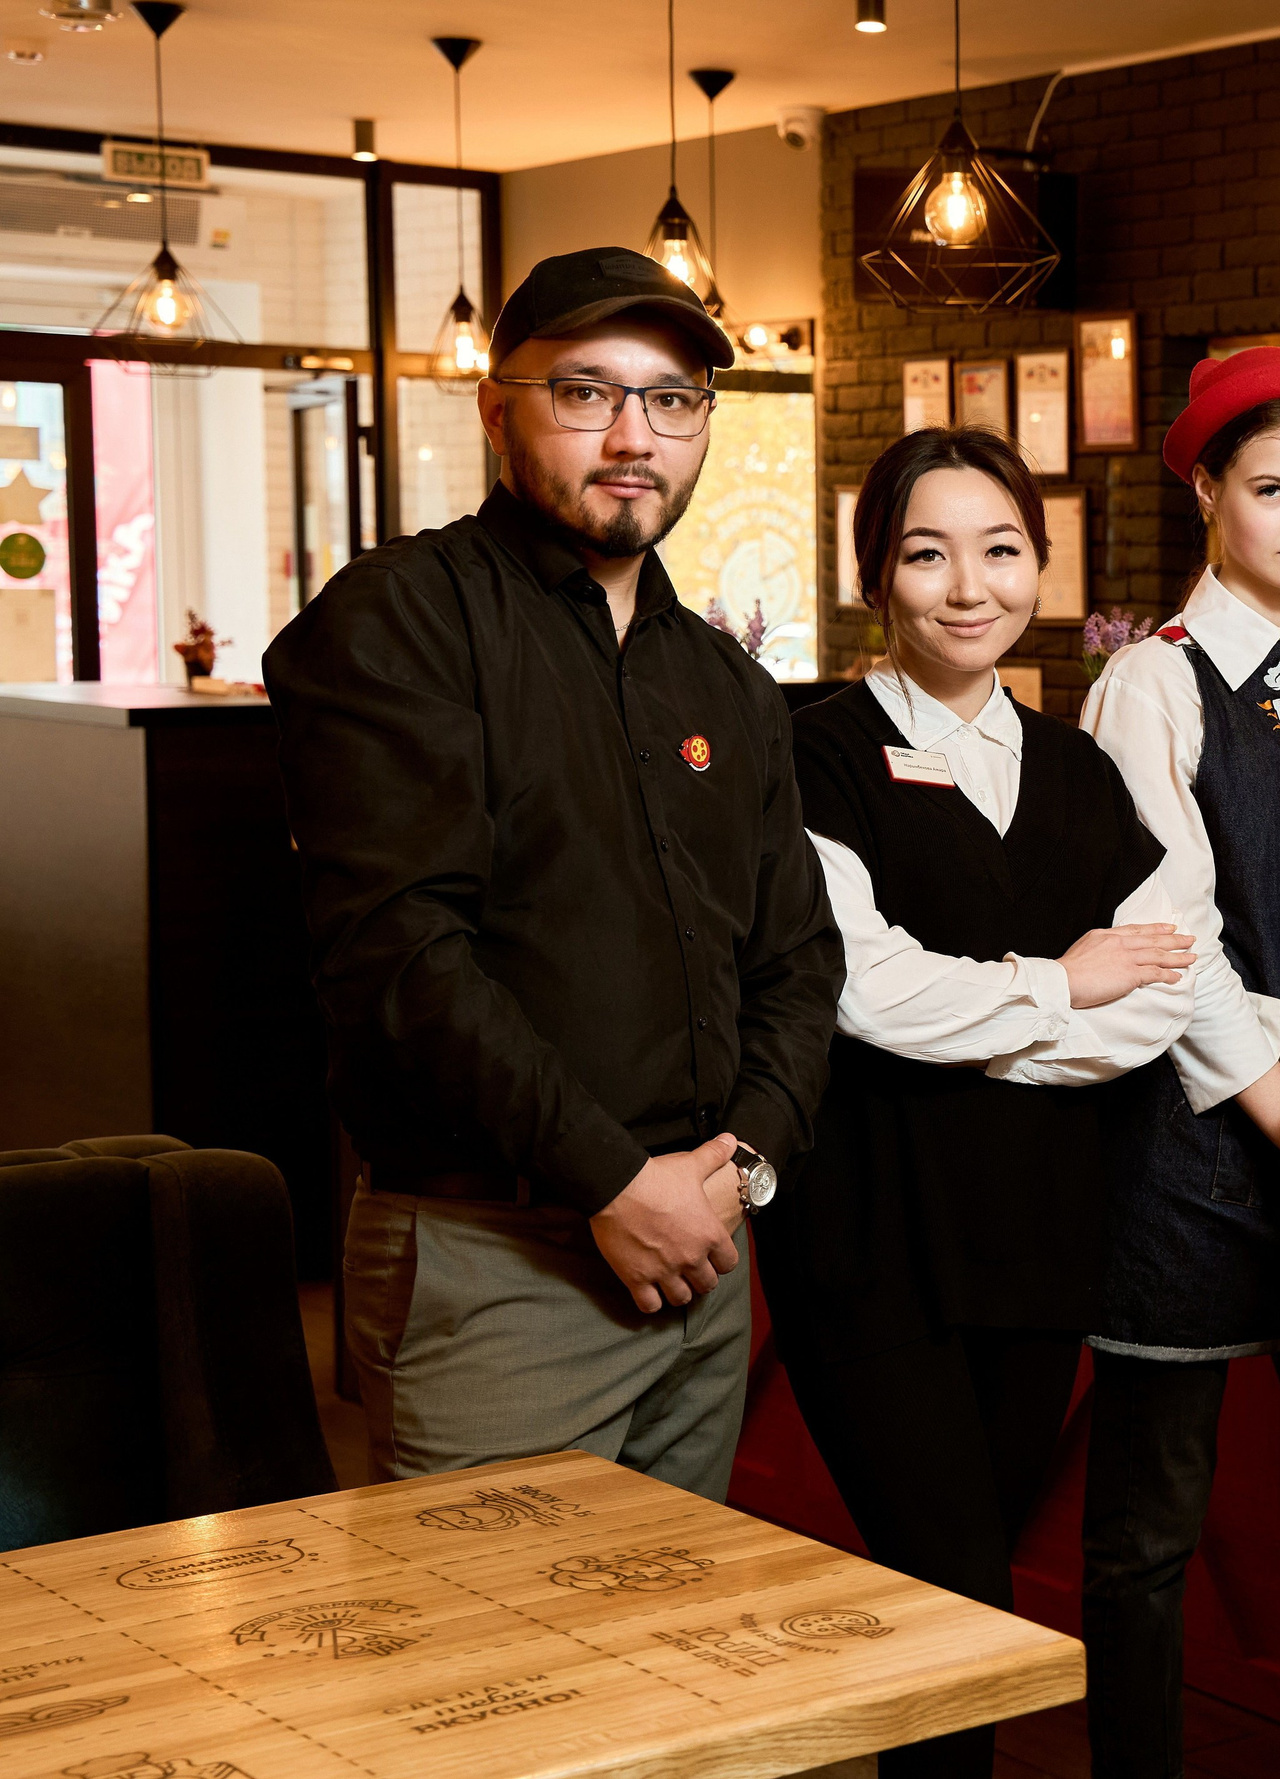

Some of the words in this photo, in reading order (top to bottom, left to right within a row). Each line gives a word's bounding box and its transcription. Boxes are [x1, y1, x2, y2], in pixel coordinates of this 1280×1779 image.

[510, 1484, 564, 1504] КОФЕ
[143, 1550, 269, 1578] аппетита!
[148, 1555, 286, 1583] Приятного
[679, 1626, 790, 1667] ПИРОГ
[383, 1674, 549, 1715] СДЕЛАЕМ
[434, 1688, 536, 1716] тебе
[411, 1688, 585, 1734] ВКУСНО!
